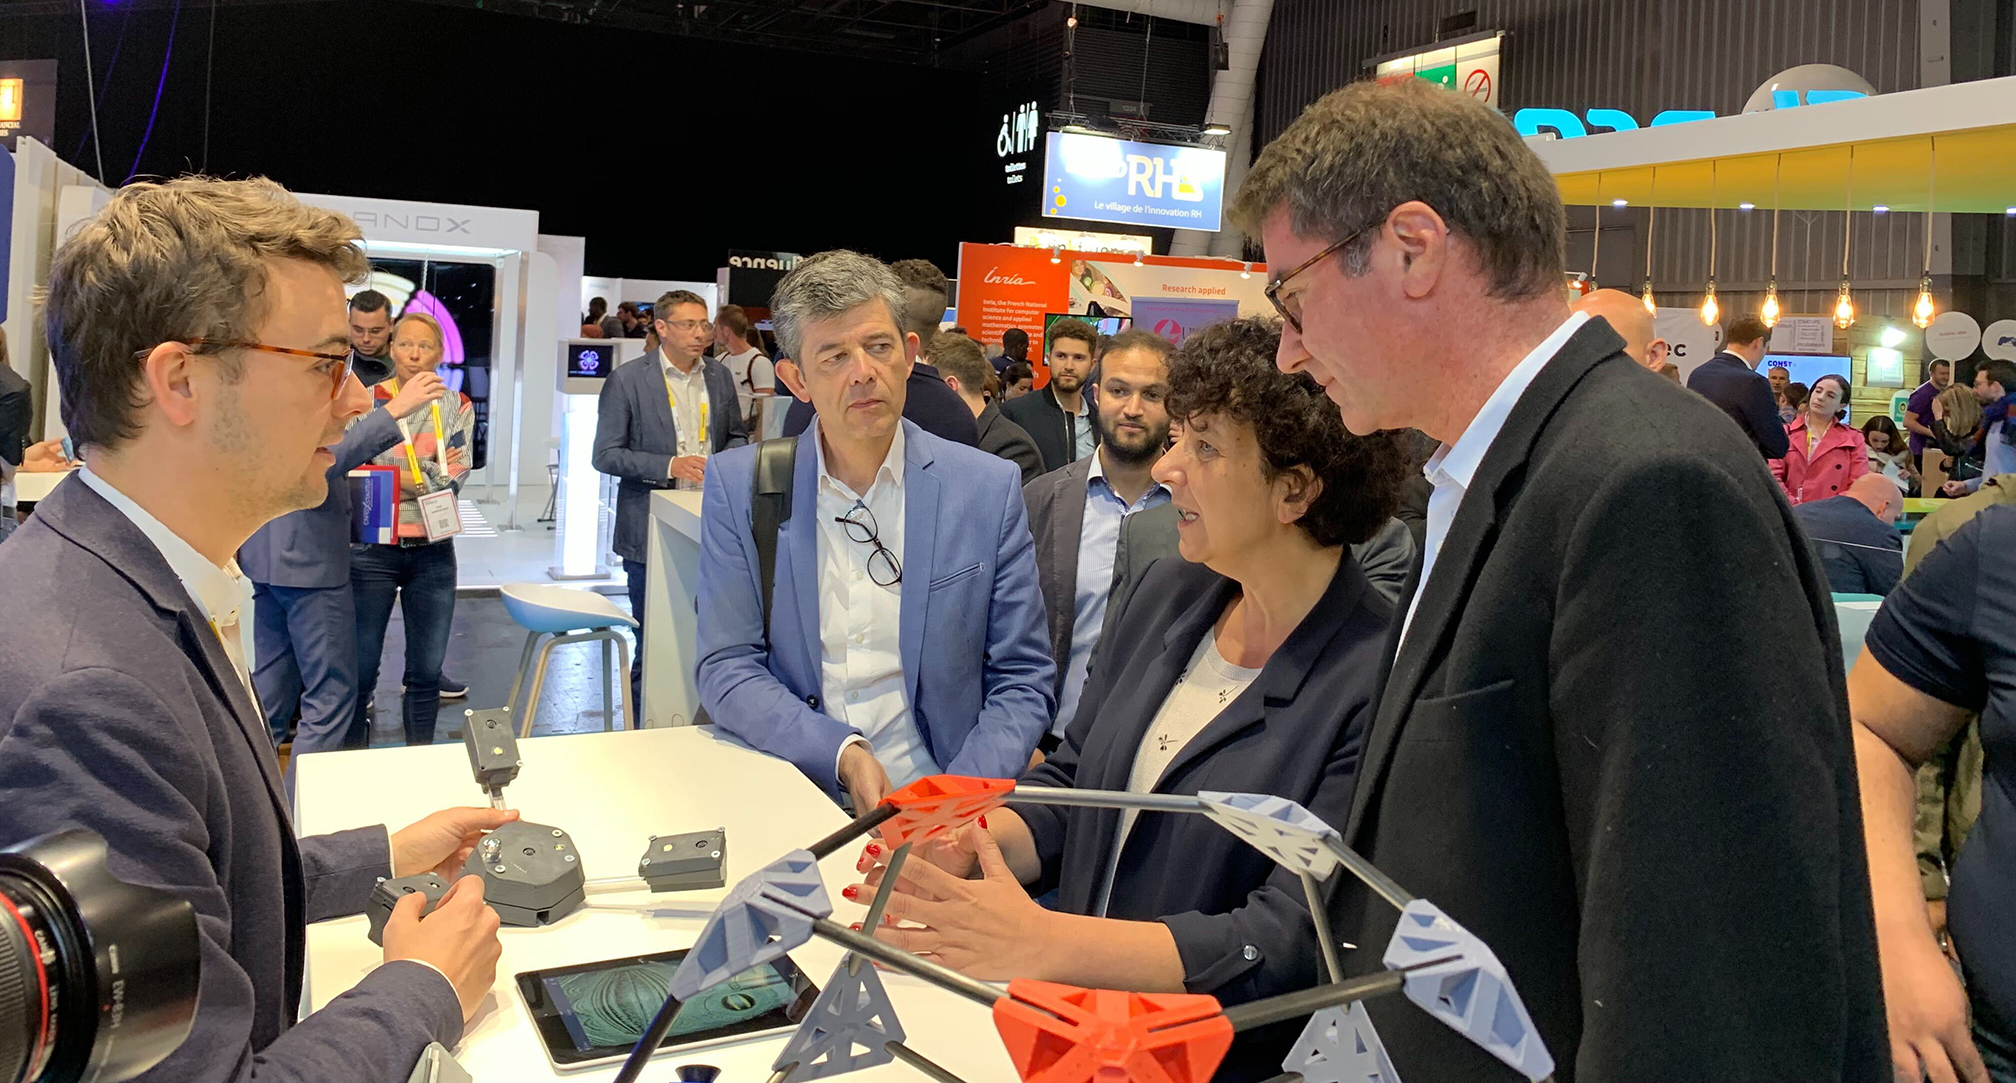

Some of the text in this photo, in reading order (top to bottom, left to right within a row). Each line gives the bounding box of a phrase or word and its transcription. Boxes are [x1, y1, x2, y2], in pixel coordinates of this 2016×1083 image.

[1095, 201, 1202, 219] Le village de l'innovation RH
[1162, 284, 1226, 296] Research applied
